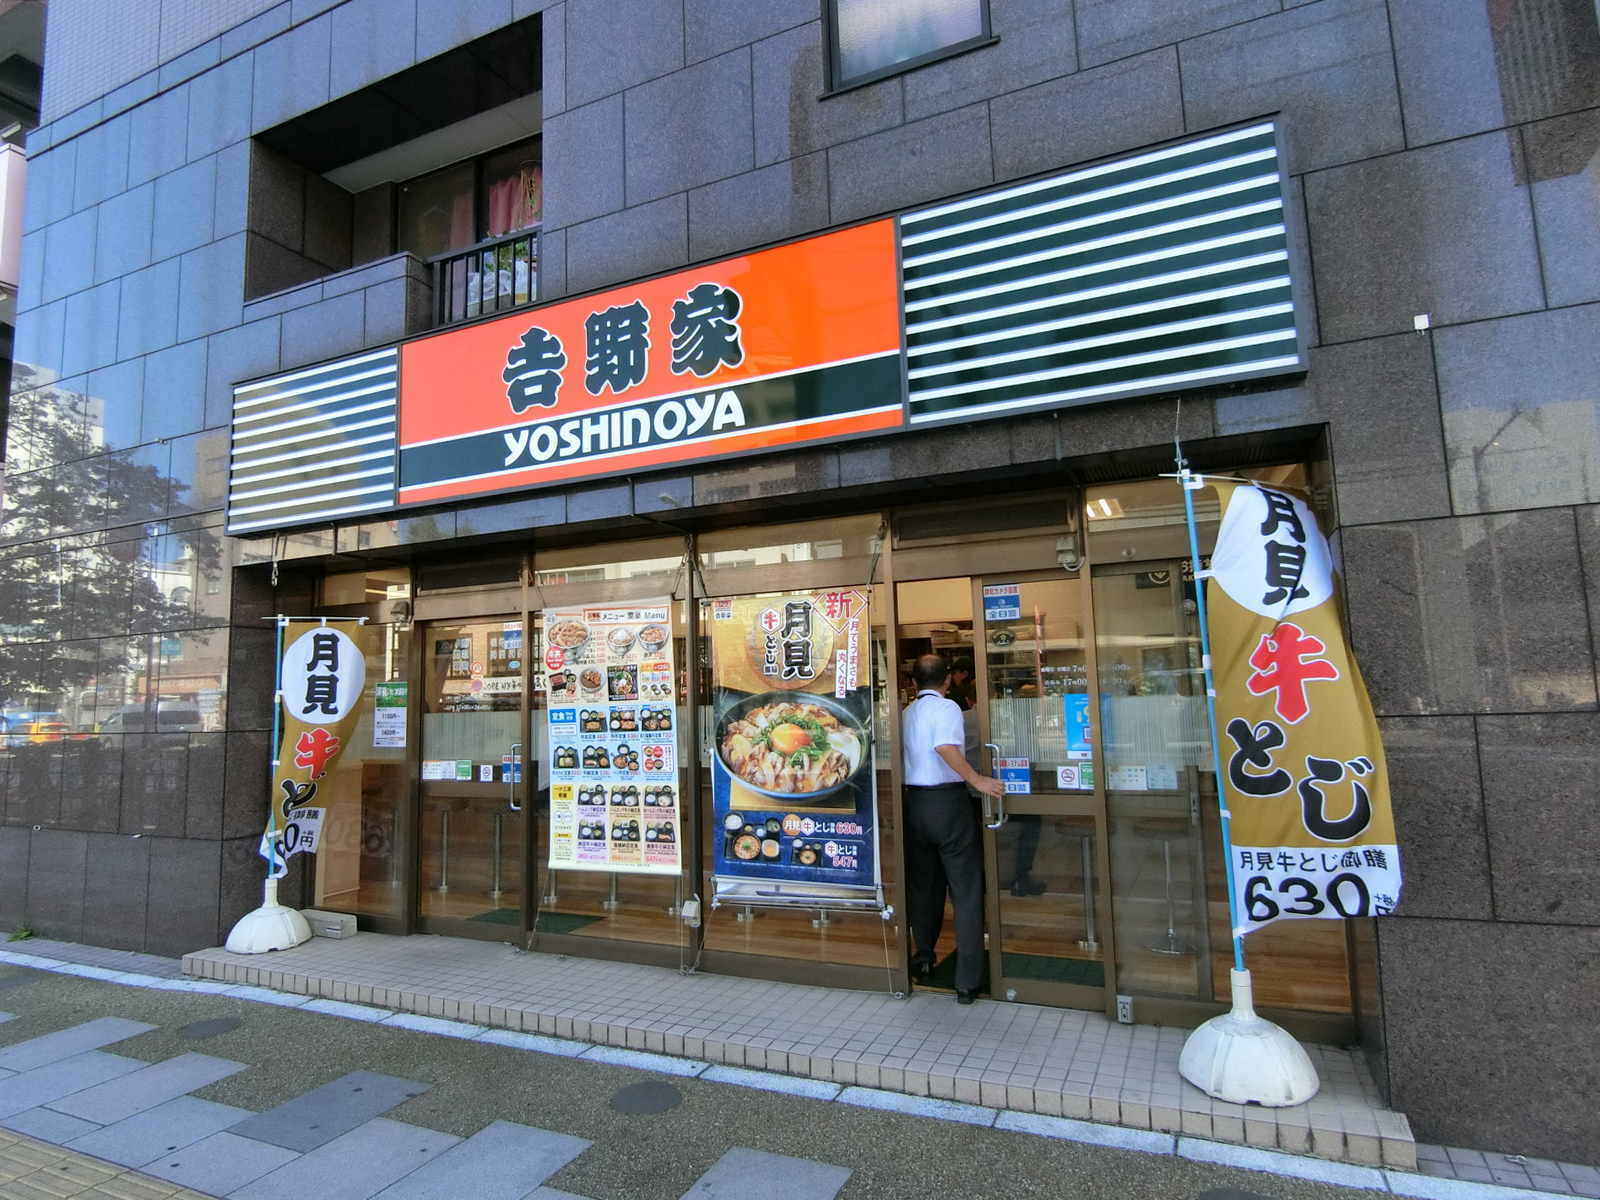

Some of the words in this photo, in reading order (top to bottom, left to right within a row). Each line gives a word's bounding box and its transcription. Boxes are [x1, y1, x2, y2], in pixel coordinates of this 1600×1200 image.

[504, 390, 746, 467] YOSHINOYA
[602, 612, 625, 620] メニュー
[644, 611, 666, 619] Menu
[825, 591, 853, 619] 新
[780, 601, 815, 679] 月見
[302, 633, 340, 715] 月見
[837, 652, 847, 696] 丸くなる
[1240, 849, 1388, 872] 月見牛とじ御膳
